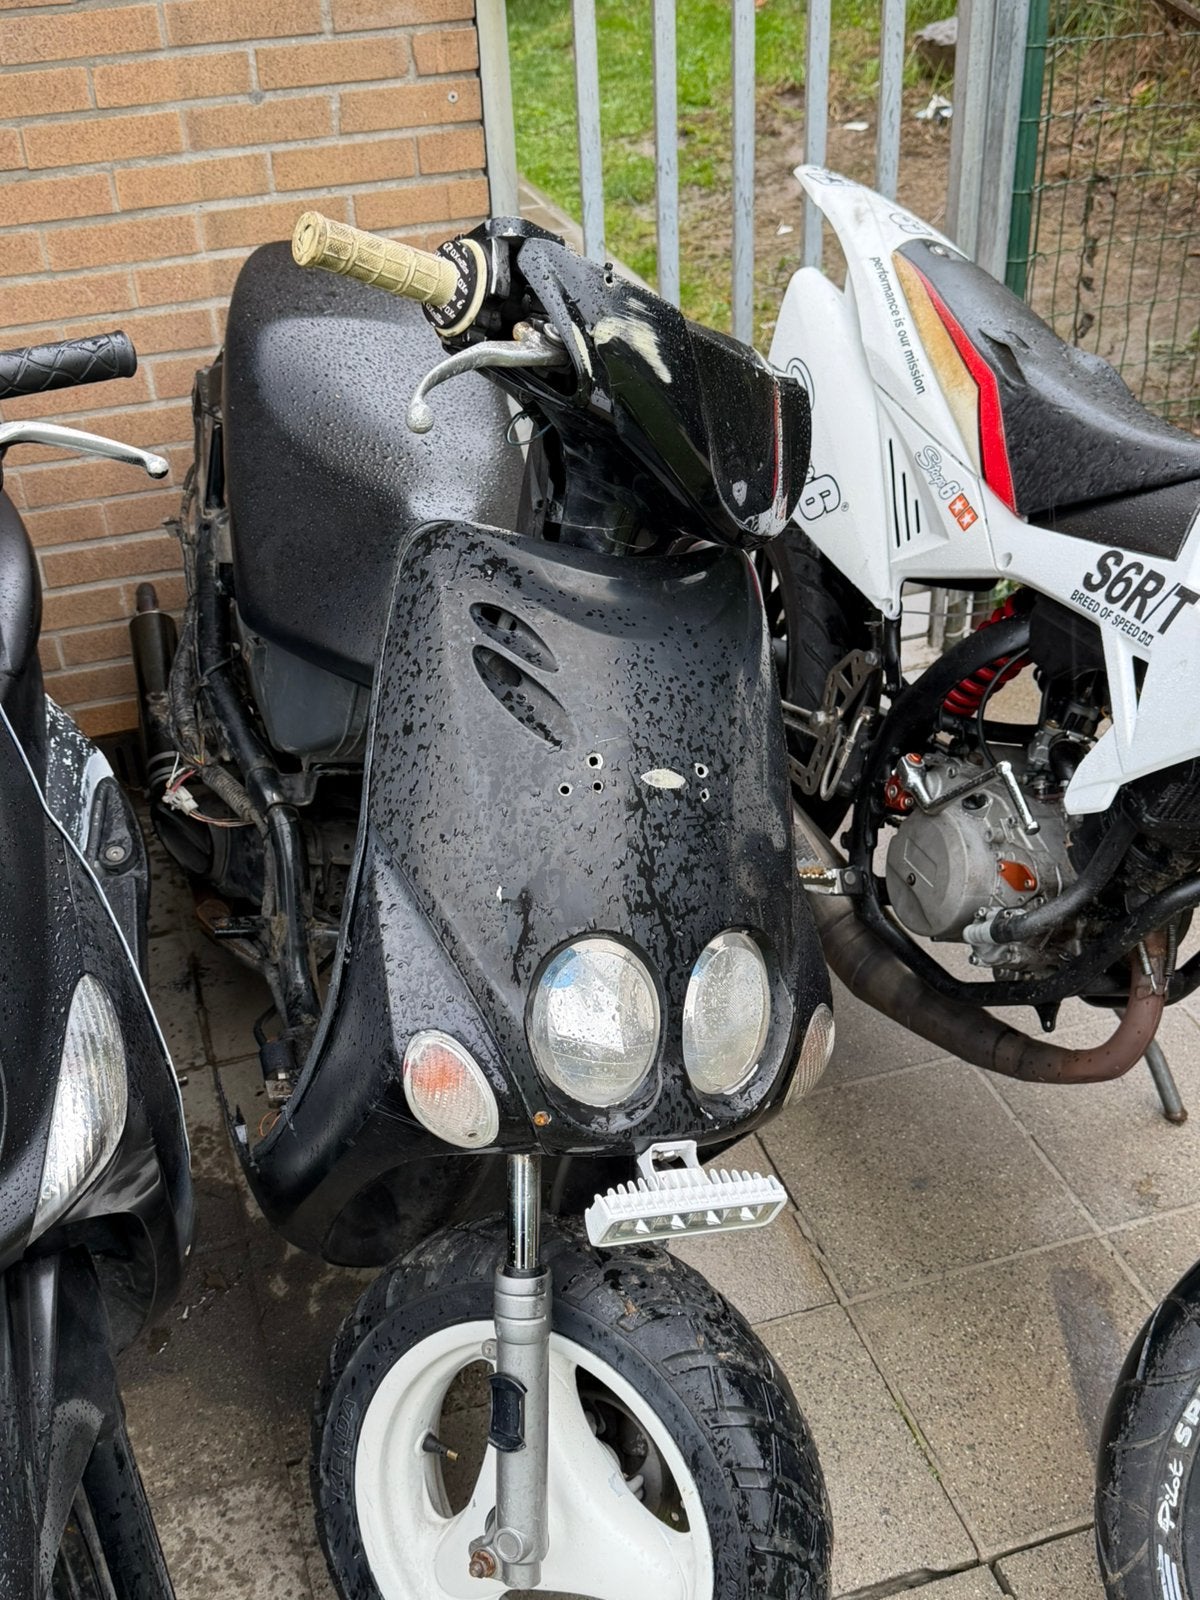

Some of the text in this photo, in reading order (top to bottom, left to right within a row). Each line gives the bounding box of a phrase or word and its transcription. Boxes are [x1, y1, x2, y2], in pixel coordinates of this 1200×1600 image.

[870, 256, 926, 395] performance is our mission
[1070, 589, 1141, 638] BREED OF SPEED
[1082, 550, 1200, 635] S6R/T
[331, 1397, 357, 1500] KENDA
